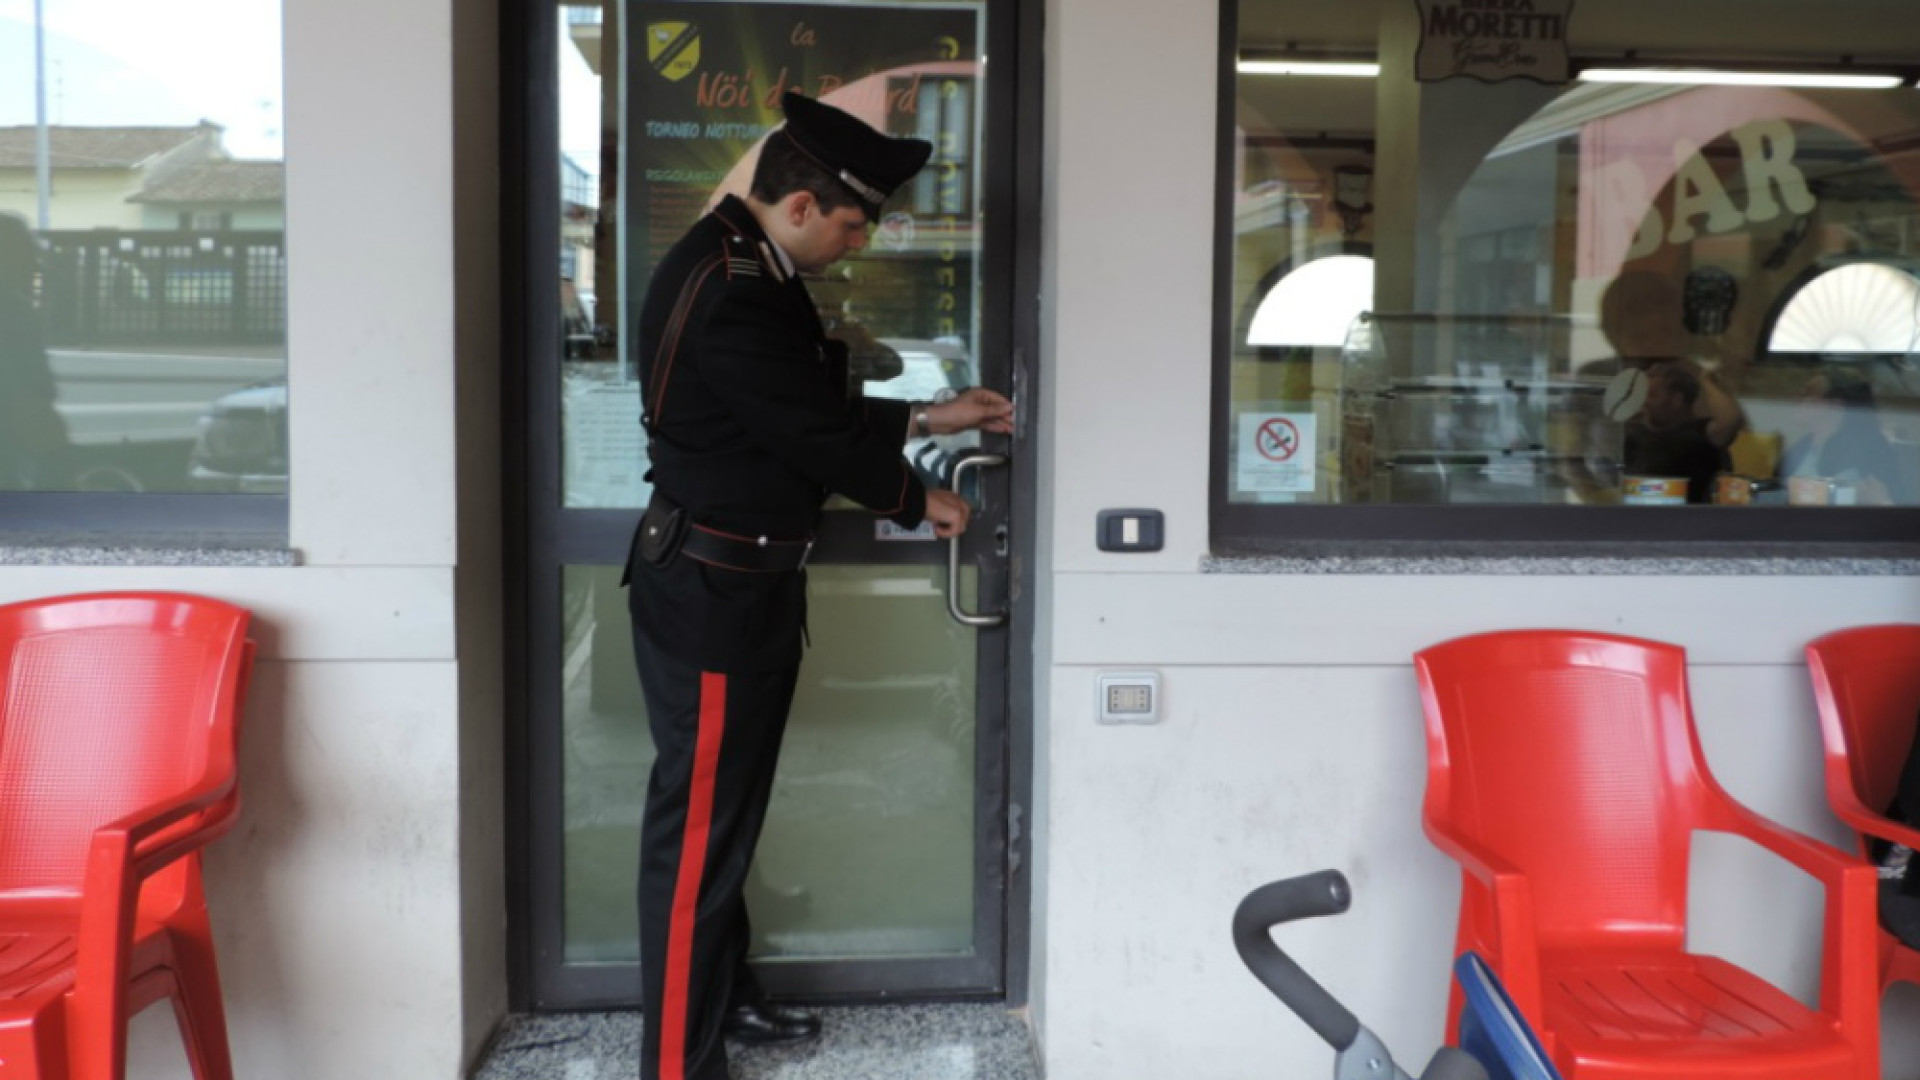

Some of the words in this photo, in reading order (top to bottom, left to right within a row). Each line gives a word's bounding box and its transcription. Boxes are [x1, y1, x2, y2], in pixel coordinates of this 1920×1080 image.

[790, 20, 816, 48] la
[1428, 5, 1563, 40] MORETTI
[697, 70, 753, 109] Nöi
[646, 121, 700, 138] TORNEO
[1583, 117, 1817, 263] BAR
